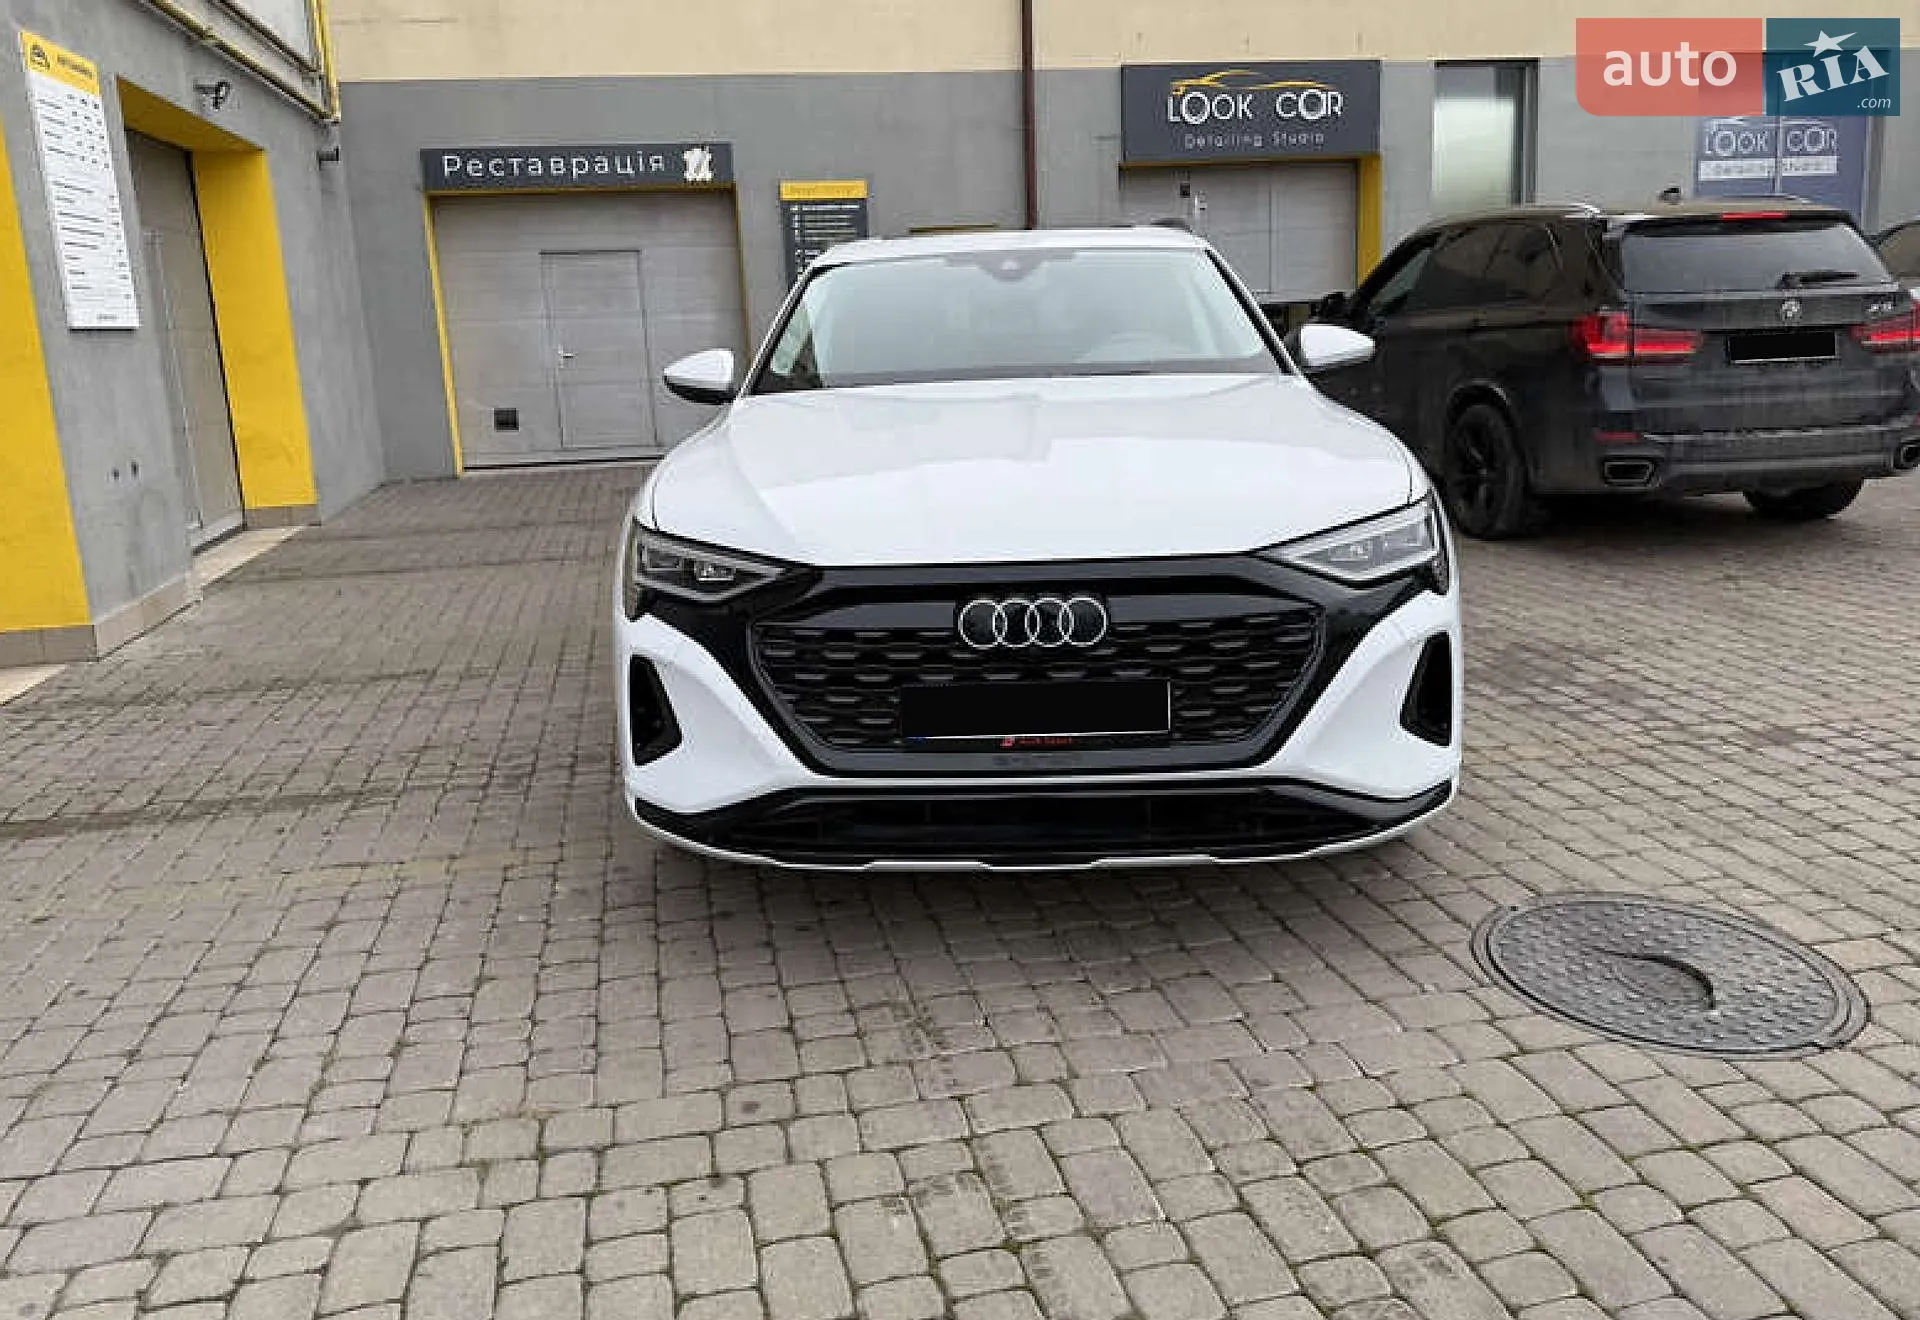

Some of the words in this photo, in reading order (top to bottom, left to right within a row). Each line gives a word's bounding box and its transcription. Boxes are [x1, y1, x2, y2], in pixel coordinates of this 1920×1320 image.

[1168, 91, 1252, 124] LOOK
[1704, 129, 1769, 157] LOOK
[441, 151, 665, 179] Реставрація
